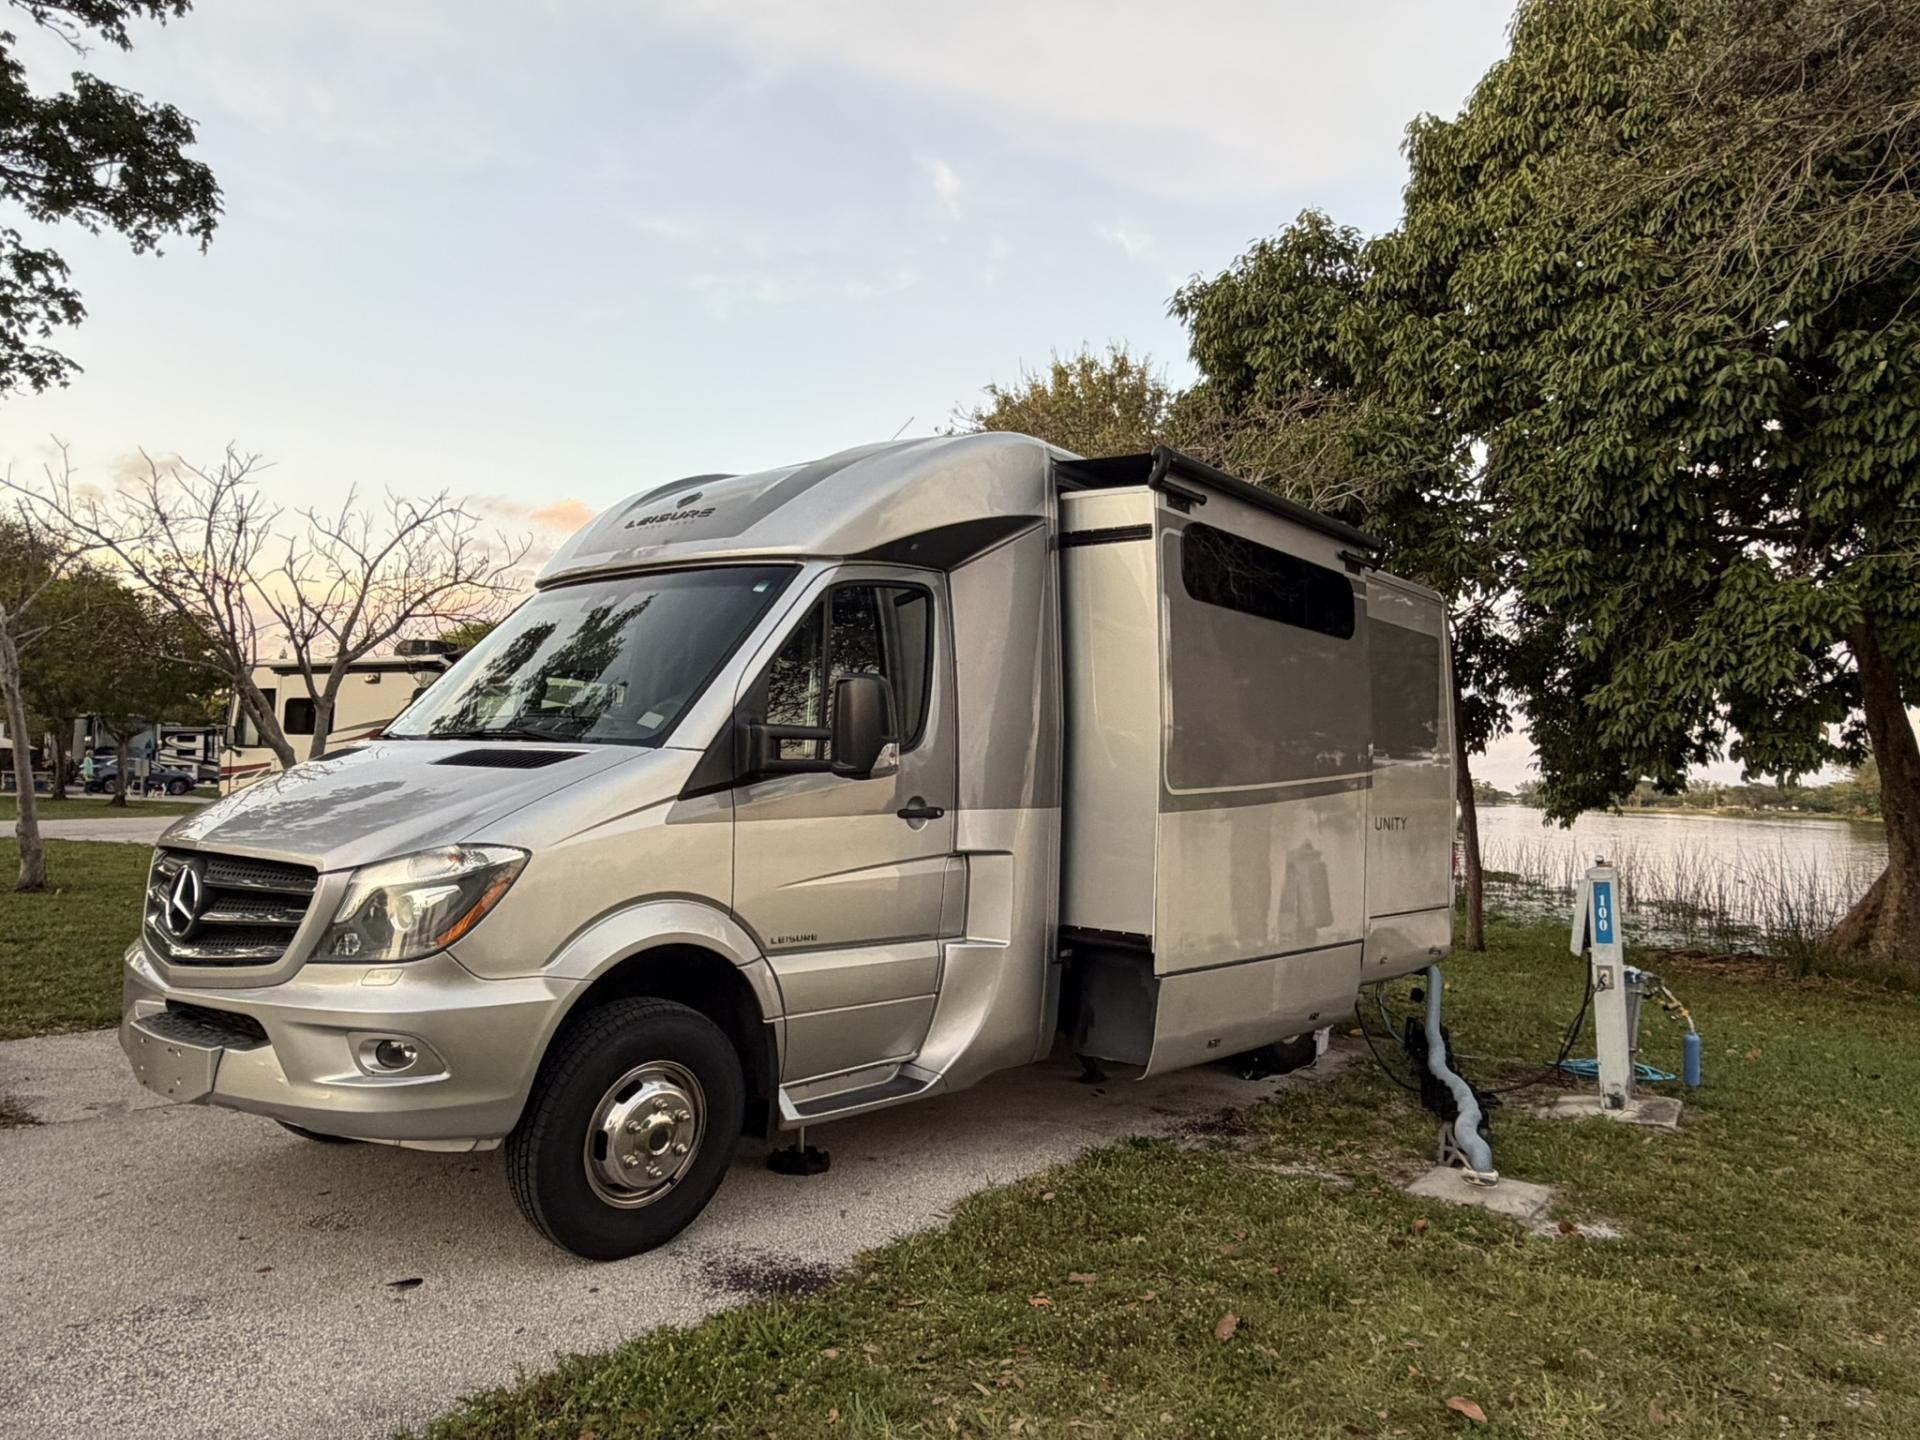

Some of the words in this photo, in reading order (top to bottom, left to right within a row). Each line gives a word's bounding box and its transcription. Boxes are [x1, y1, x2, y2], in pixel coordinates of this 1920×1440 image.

[624, 507, 716, 529] LEISURE
[1374, 816, 1408, 831] UNITY
[1598, 894, 1608, 931] 100
